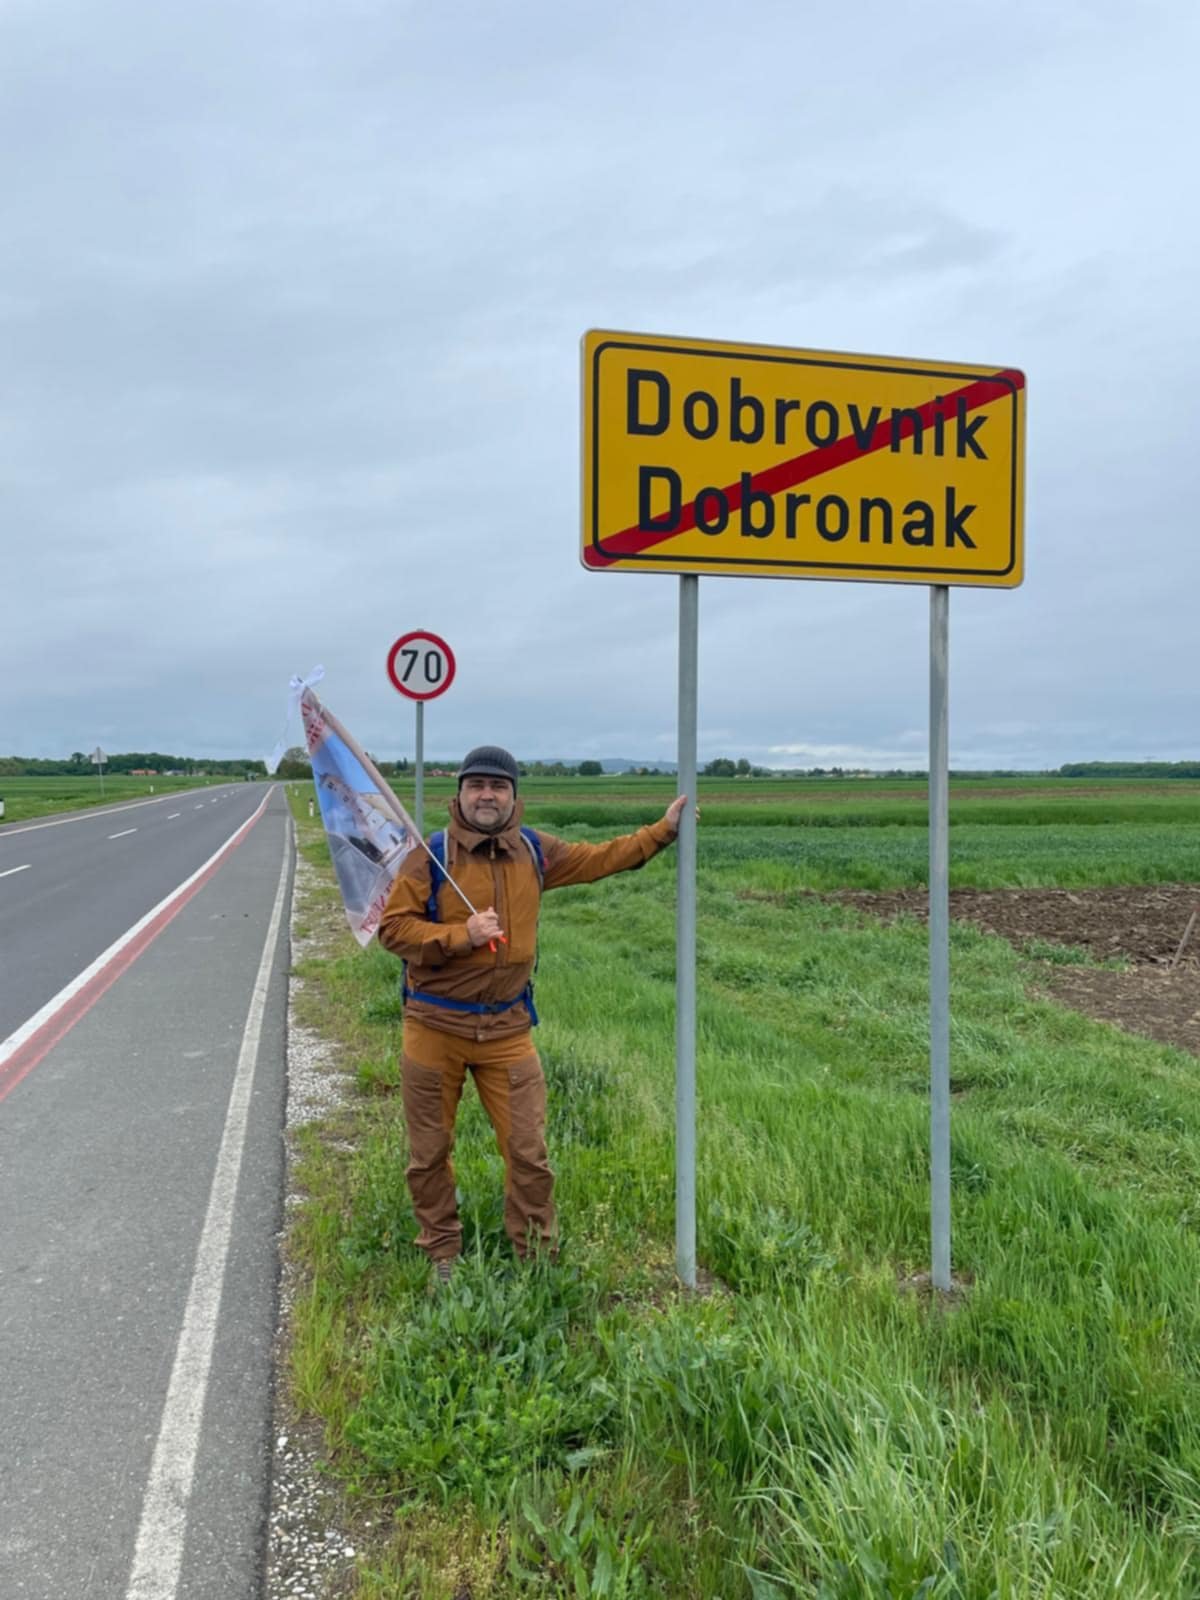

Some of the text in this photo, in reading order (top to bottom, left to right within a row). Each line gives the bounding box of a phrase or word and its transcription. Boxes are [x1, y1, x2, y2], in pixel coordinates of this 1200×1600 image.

[626, 368, 988, 460] Dobrovnik
[638, 465, 977, 549] Dobronak
[400, 649, 442, 684] 70
